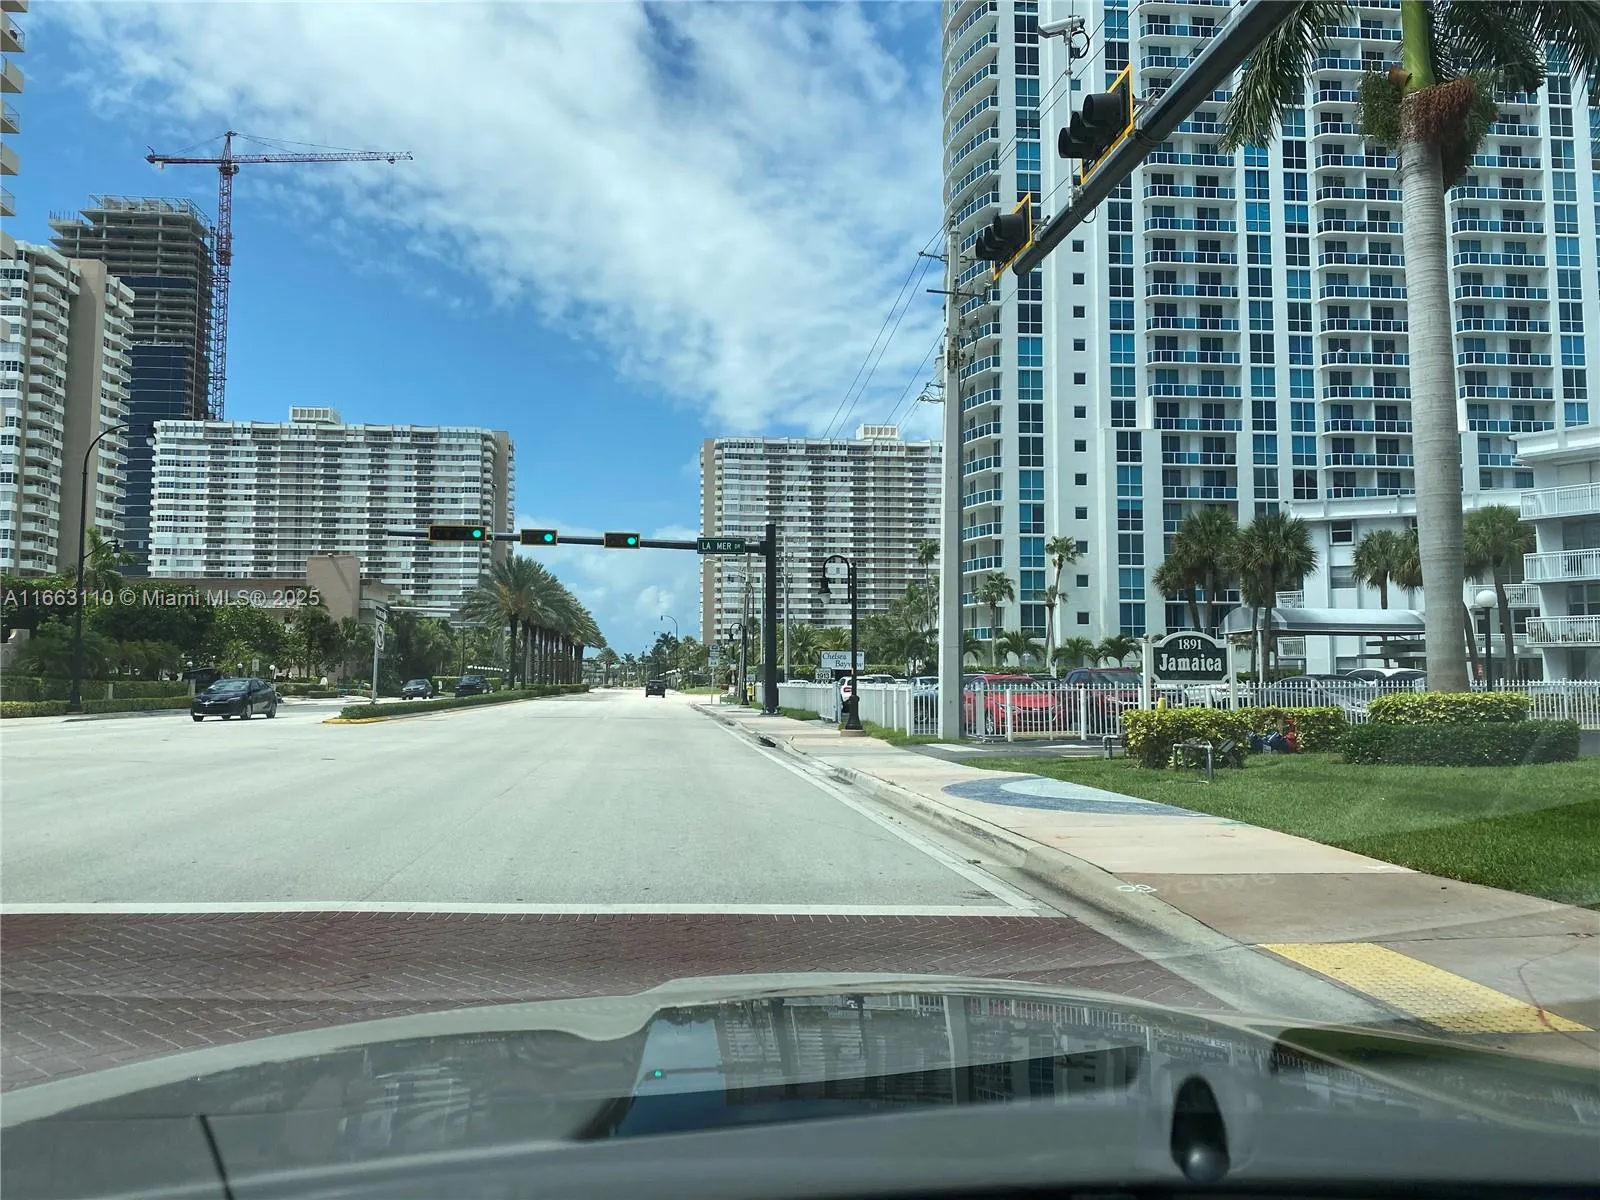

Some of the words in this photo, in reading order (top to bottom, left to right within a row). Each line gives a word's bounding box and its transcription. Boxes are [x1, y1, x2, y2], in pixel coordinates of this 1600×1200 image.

[702, 542, 711, 550] LA
[717, 542, 732, 550] MER
[1178, 639, 1202, 649] 1891
[823, 652, 847, 660] Chelsea
[1159, 653, 1222, 671] Jamaica
